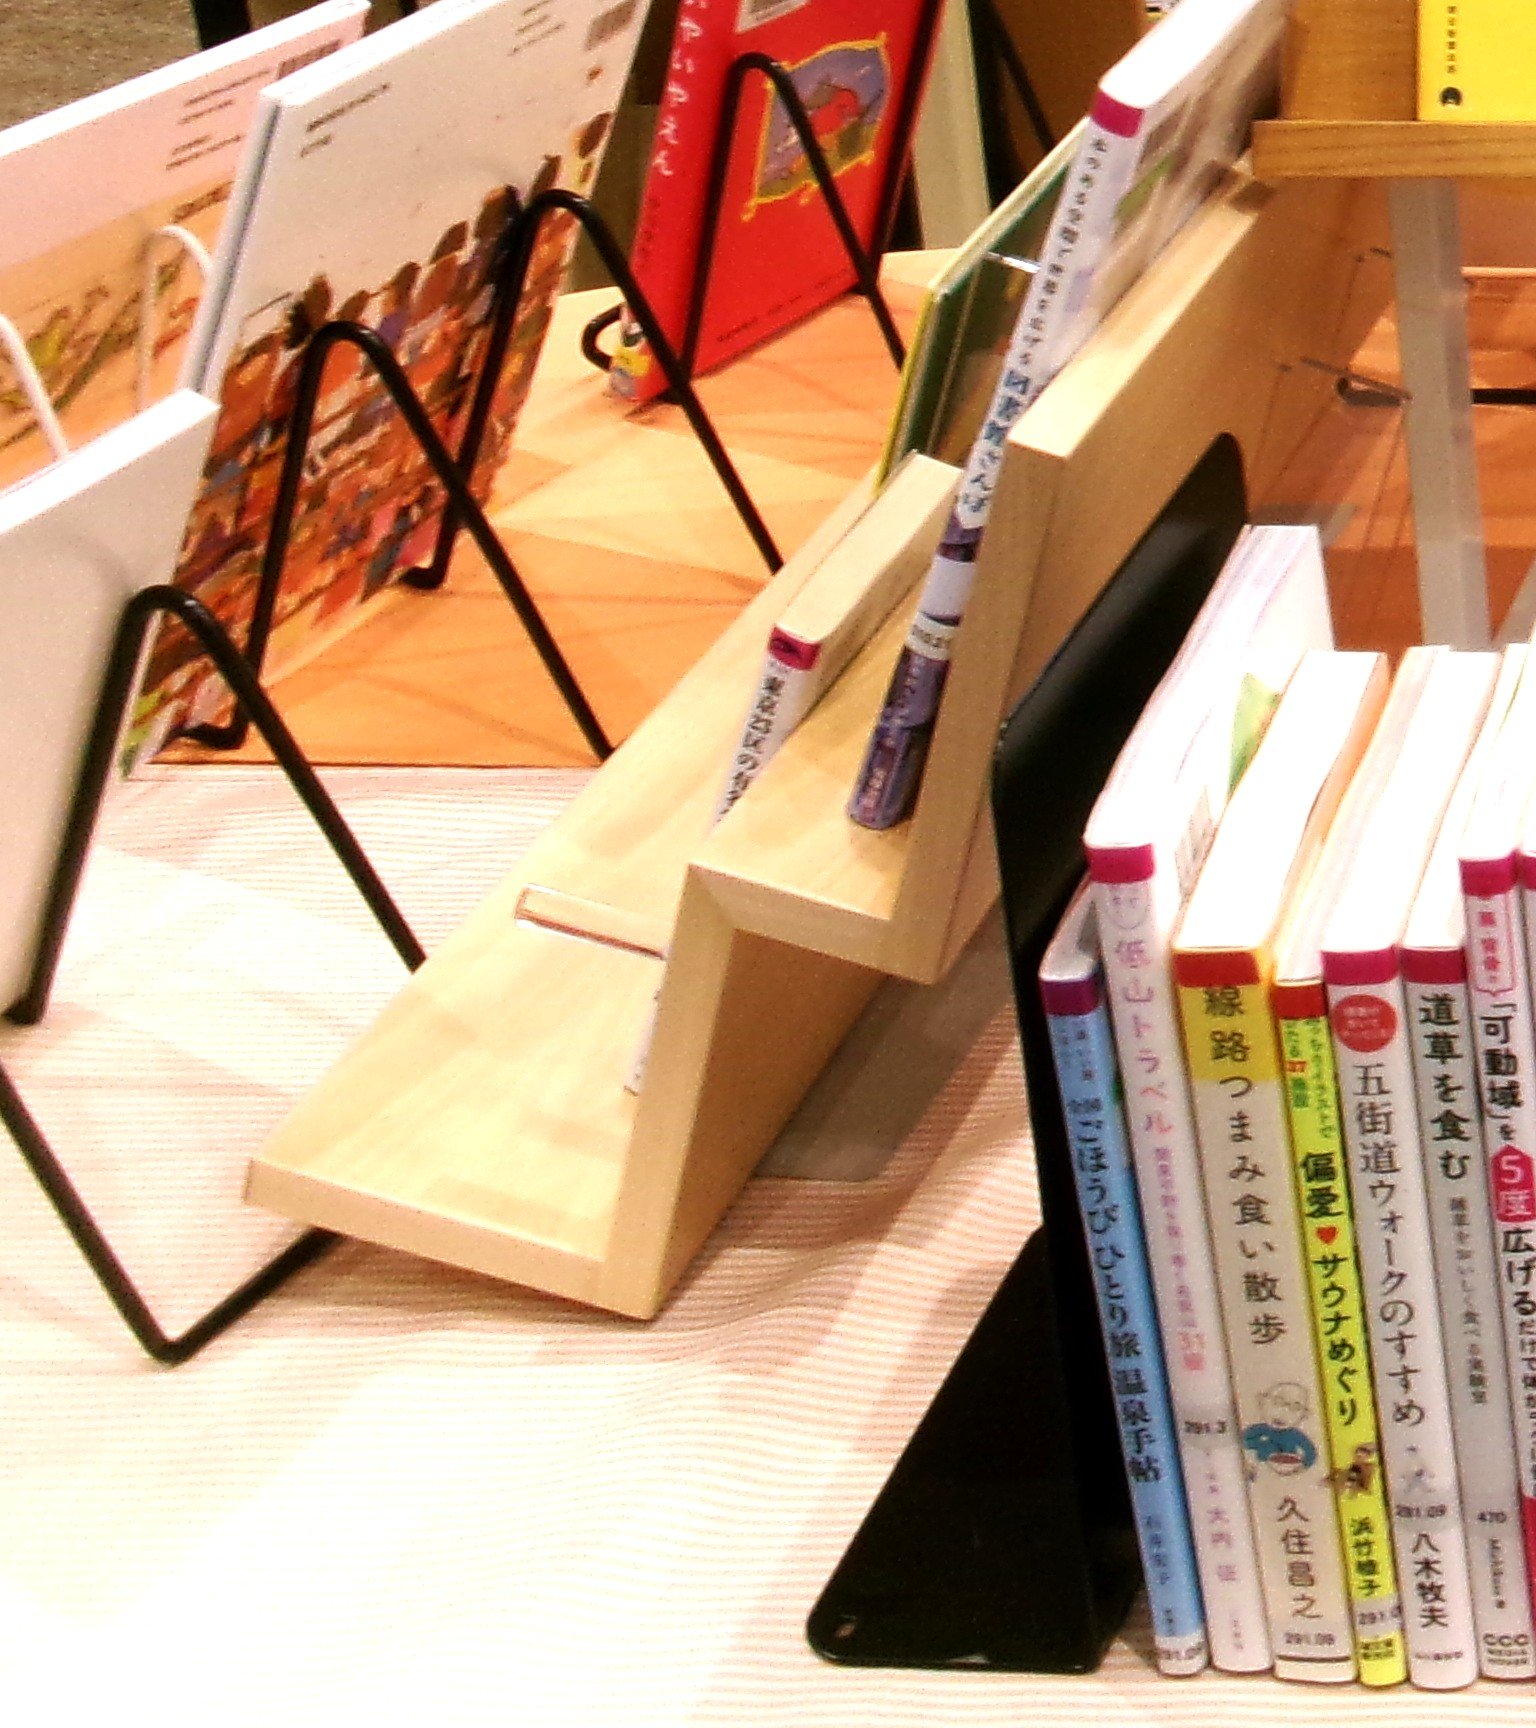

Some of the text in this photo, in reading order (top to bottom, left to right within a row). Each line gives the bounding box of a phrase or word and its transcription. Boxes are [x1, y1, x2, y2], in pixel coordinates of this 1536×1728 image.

[1114, 938, 1172, 1134] 低山トラベル
[1418, 992, 1471, 1181] 道草を食む
[1202, 985, 1290, 1347] 線路つまみ食い散歩
[1300, 1150, 1344, 1219] 偏愛
[1352, 1062, 1427, 1428] 五街道ウォークのすすめ
[1310, 1252, 1359, 1428] サウナめぐり
[1276, 1495, 1323, 1621] 久住昌之
[1410, 1532, 1449, 1630] 八木牧夫
[1482, 1632, 1529, 1647] CCC
